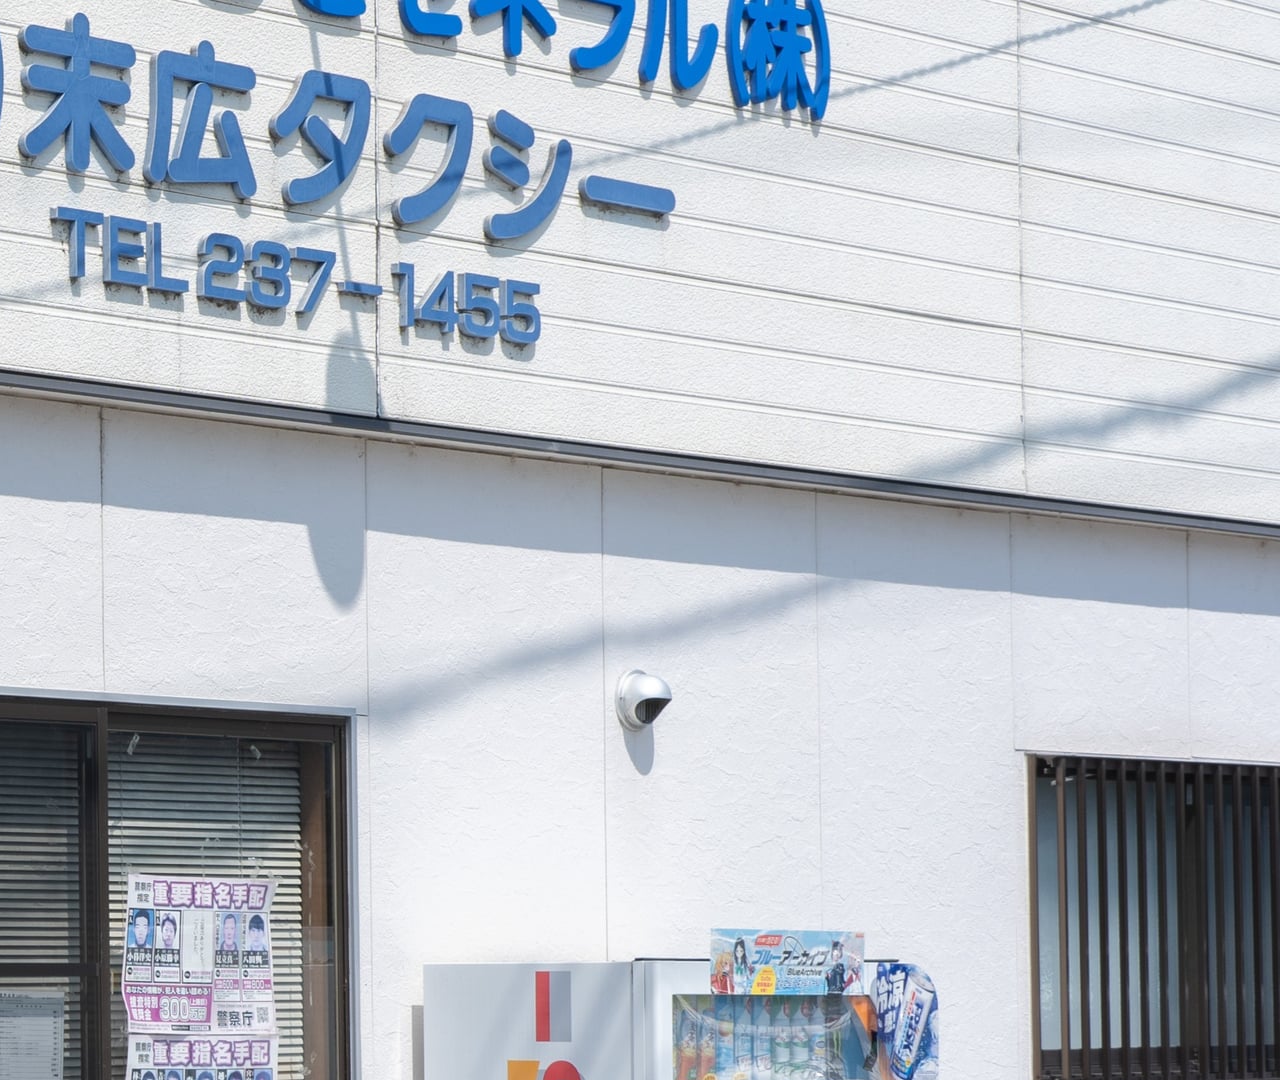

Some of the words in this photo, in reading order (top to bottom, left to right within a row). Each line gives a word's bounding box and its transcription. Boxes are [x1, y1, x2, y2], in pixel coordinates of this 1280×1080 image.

[50, 206, 189, 295] TEL
[197, 232, 541, 345] 237-1455
[153, 880, 268, 910] 重要指名手配
[217, 1010, 254, 1027] 警察庁
[153, 1040, 270, 1066] 重要指名手配
